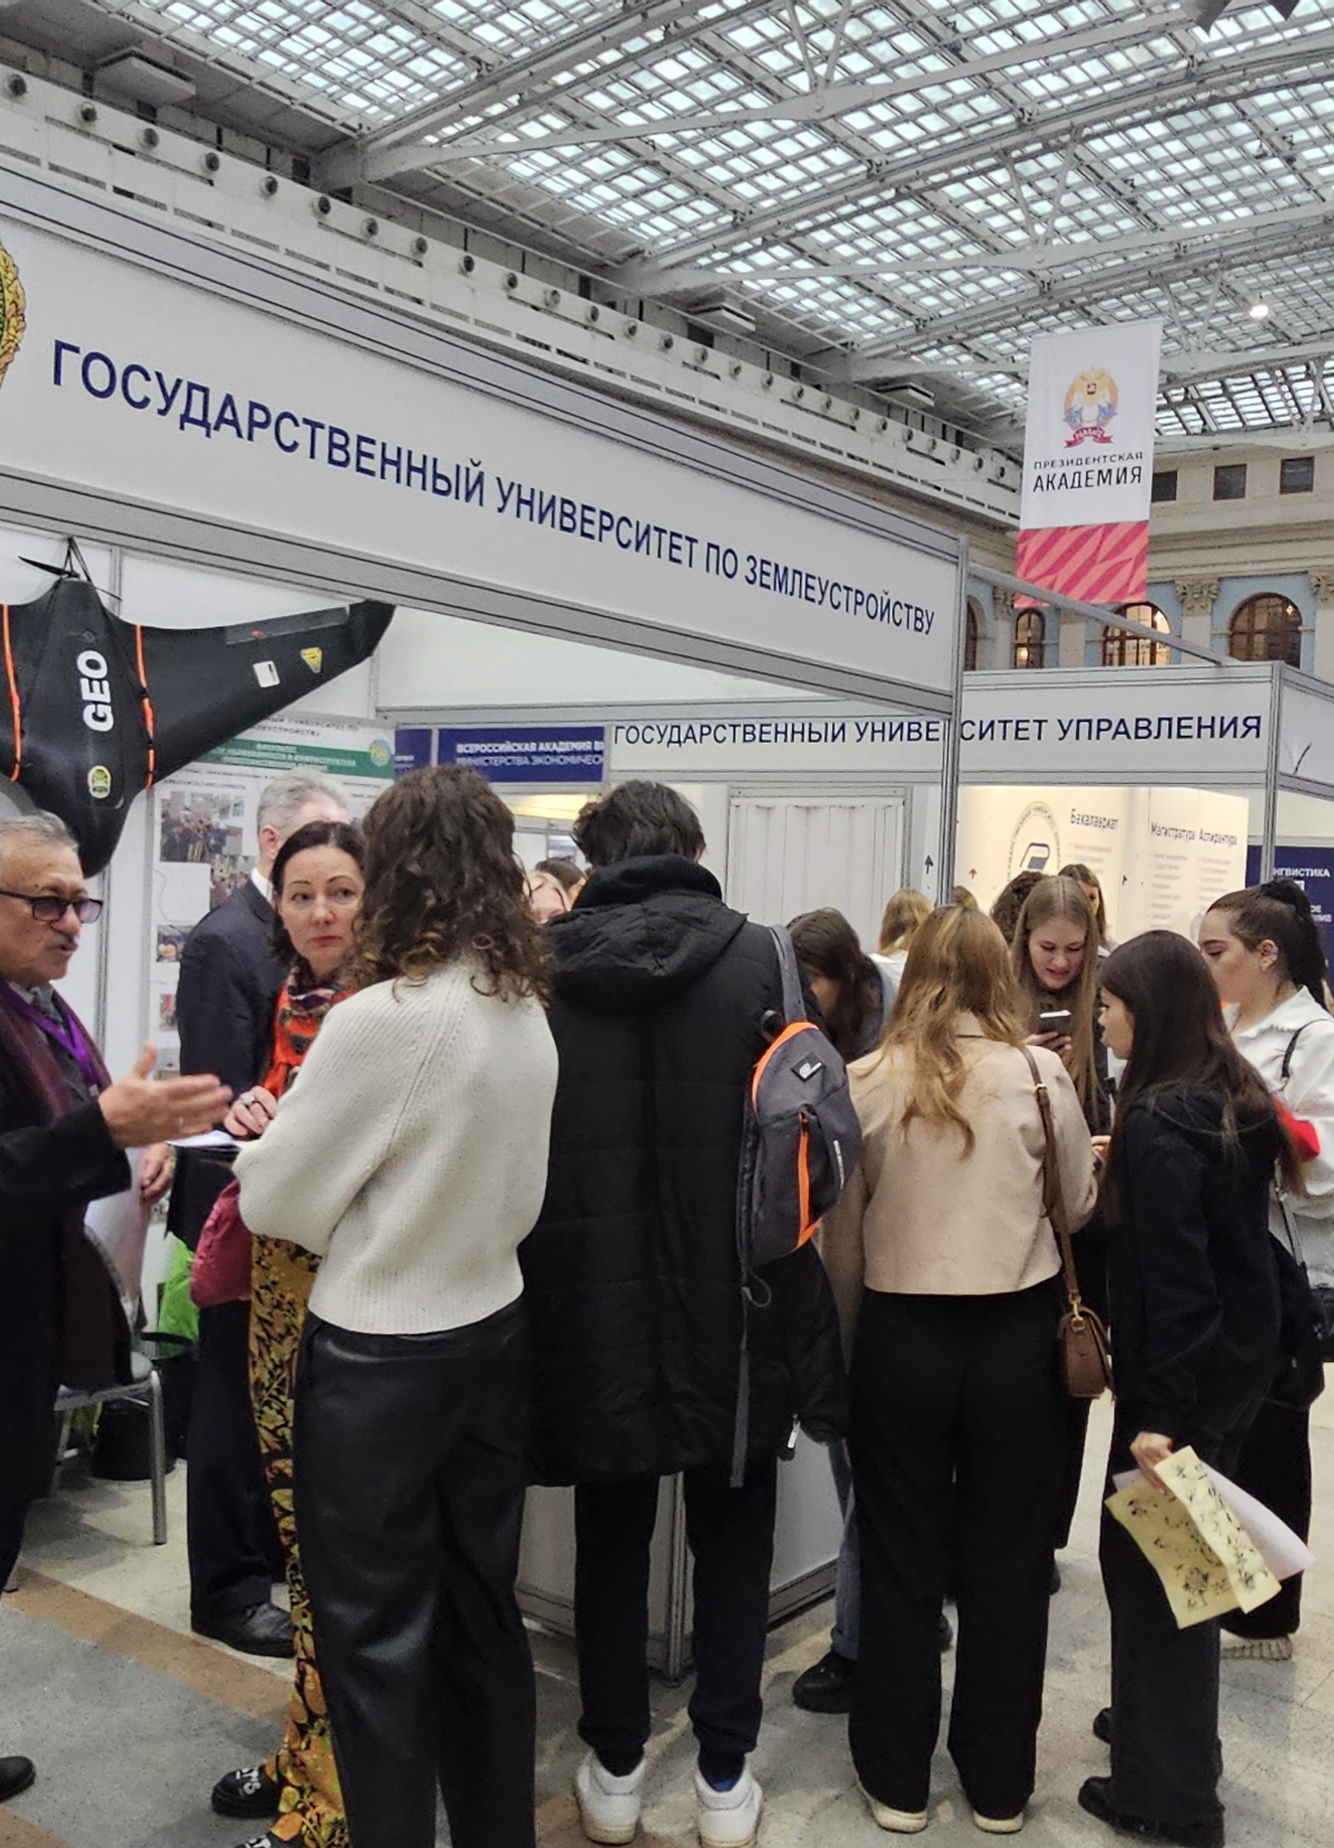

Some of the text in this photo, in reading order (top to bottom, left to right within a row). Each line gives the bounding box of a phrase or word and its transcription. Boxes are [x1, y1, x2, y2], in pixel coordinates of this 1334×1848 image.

[1034, 451, 1143, 470] ПРЕЗИДЕНТСКАЯ
[52, 339, 935, 636] ГОСУДАРСТВЕННЫЙ УНИВЕРСИТЕТ ПО ЗЕМЛЕУСТРОЙСТВУ
[1033, 466, 1142, 493] АКАДЕМИЯ
[76, 650, 114, 732] GEO
[614, 716, 1263, 748] ГОСУДАРСТВЕННЫЙ УНИВЕСИТЕТ УПРАВЛЕНИЯ
[456, 740, 537, 753] ВСЕРОССИЙСКАЯ
[538, 741, 592, 753] АКАДЕМИЯ
[1273, 867, 1331, 878] НГВИСТИКА
